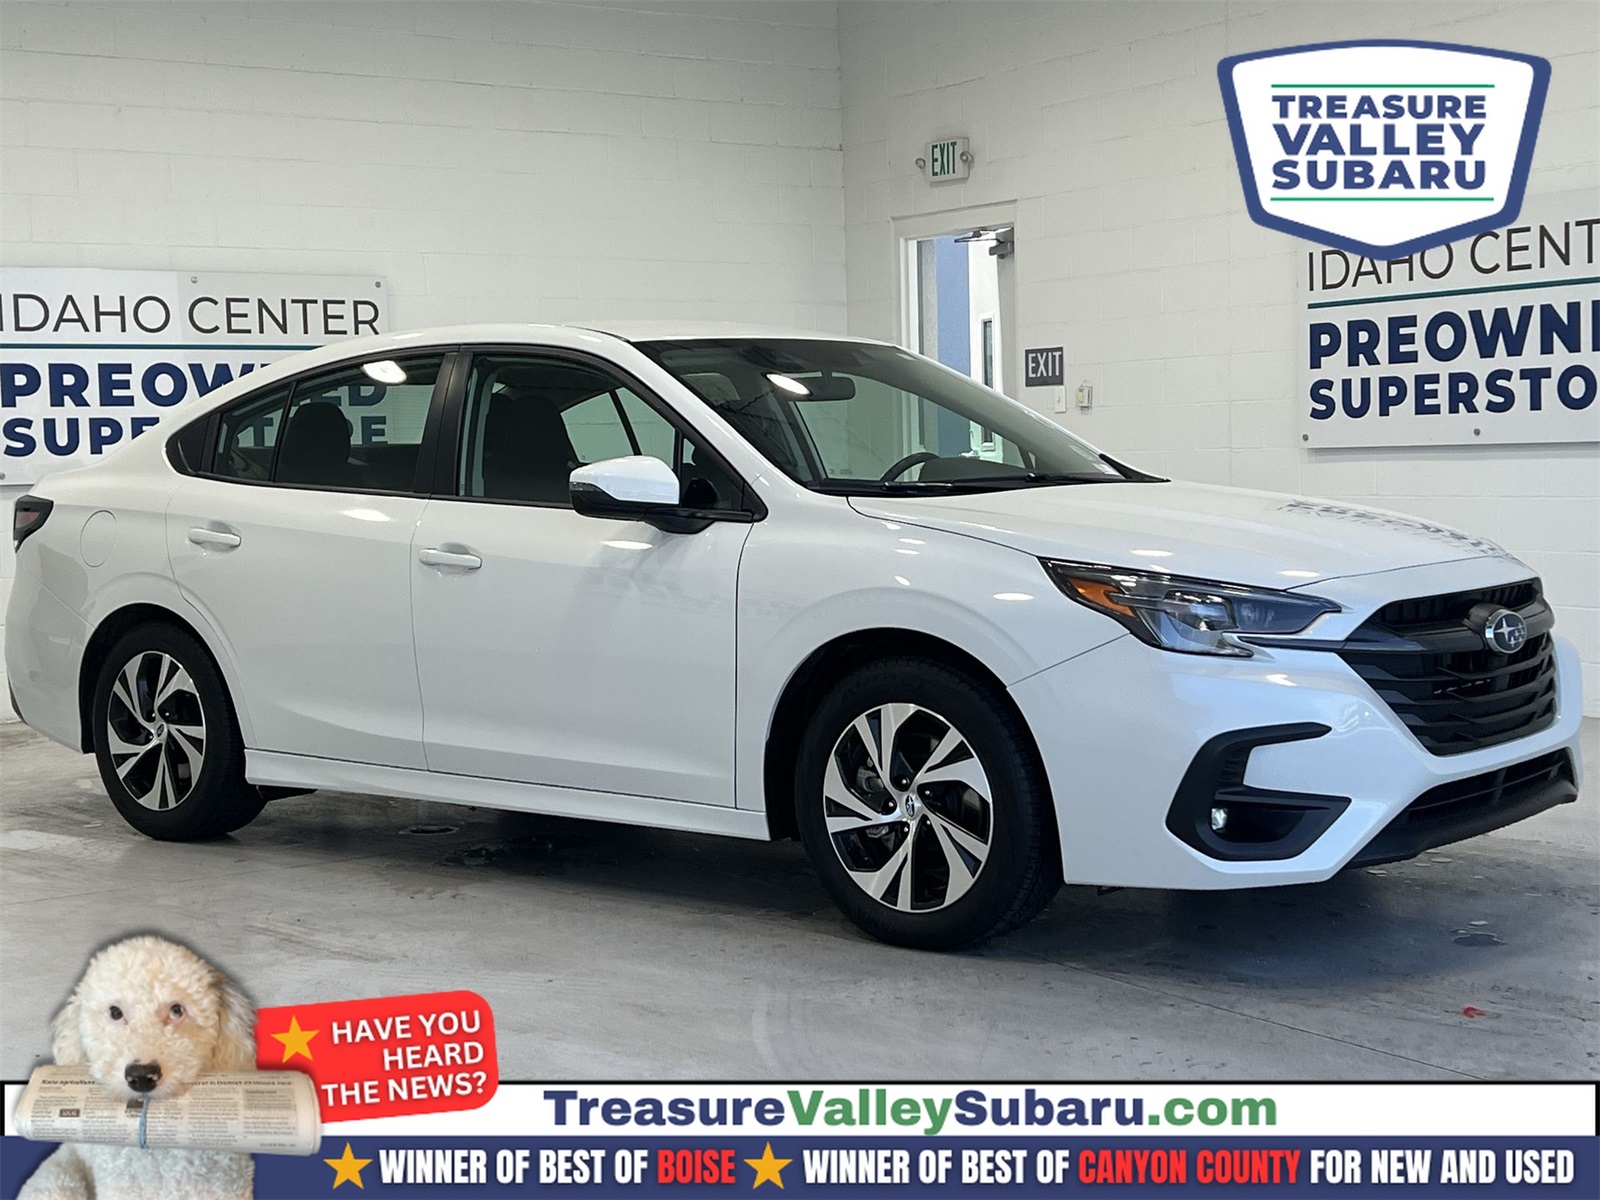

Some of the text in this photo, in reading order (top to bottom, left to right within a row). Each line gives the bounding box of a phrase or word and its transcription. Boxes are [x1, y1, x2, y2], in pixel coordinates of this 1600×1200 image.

[931, 141, 957, 177] EXIT
[1308, 218, 1600, 292] IDAHO CENT
[188, 296, 380, 336] CENTER
[1028, 351, 1062, 378] EXIT
[1309, 364, 1598, 420] SUPERSTO
